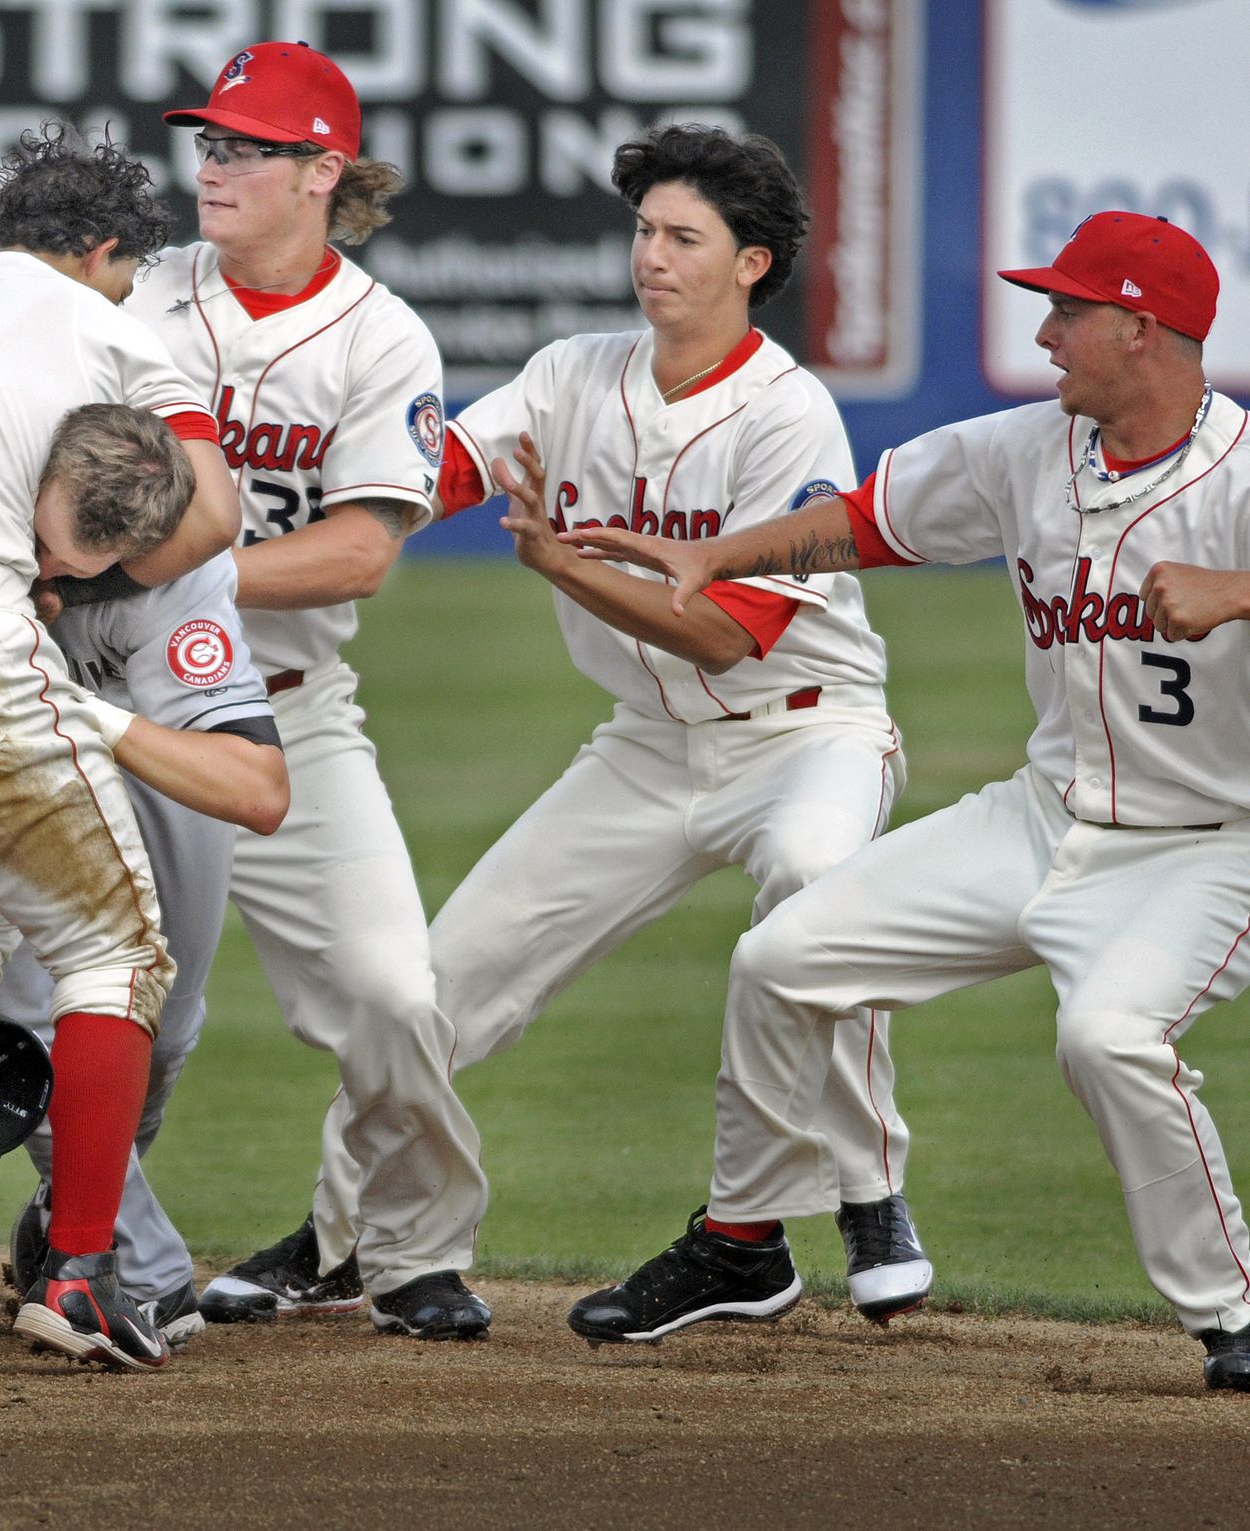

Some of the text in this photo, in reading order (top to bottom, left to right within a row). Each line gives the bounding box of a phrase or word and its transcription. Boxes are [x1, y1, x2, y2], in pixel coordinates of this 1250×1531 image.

[170, 622, 221, 647] VANCOUVER
[183, 661, 230, 684] CANADIANS
[1138, 650, 1195, 727] 3
